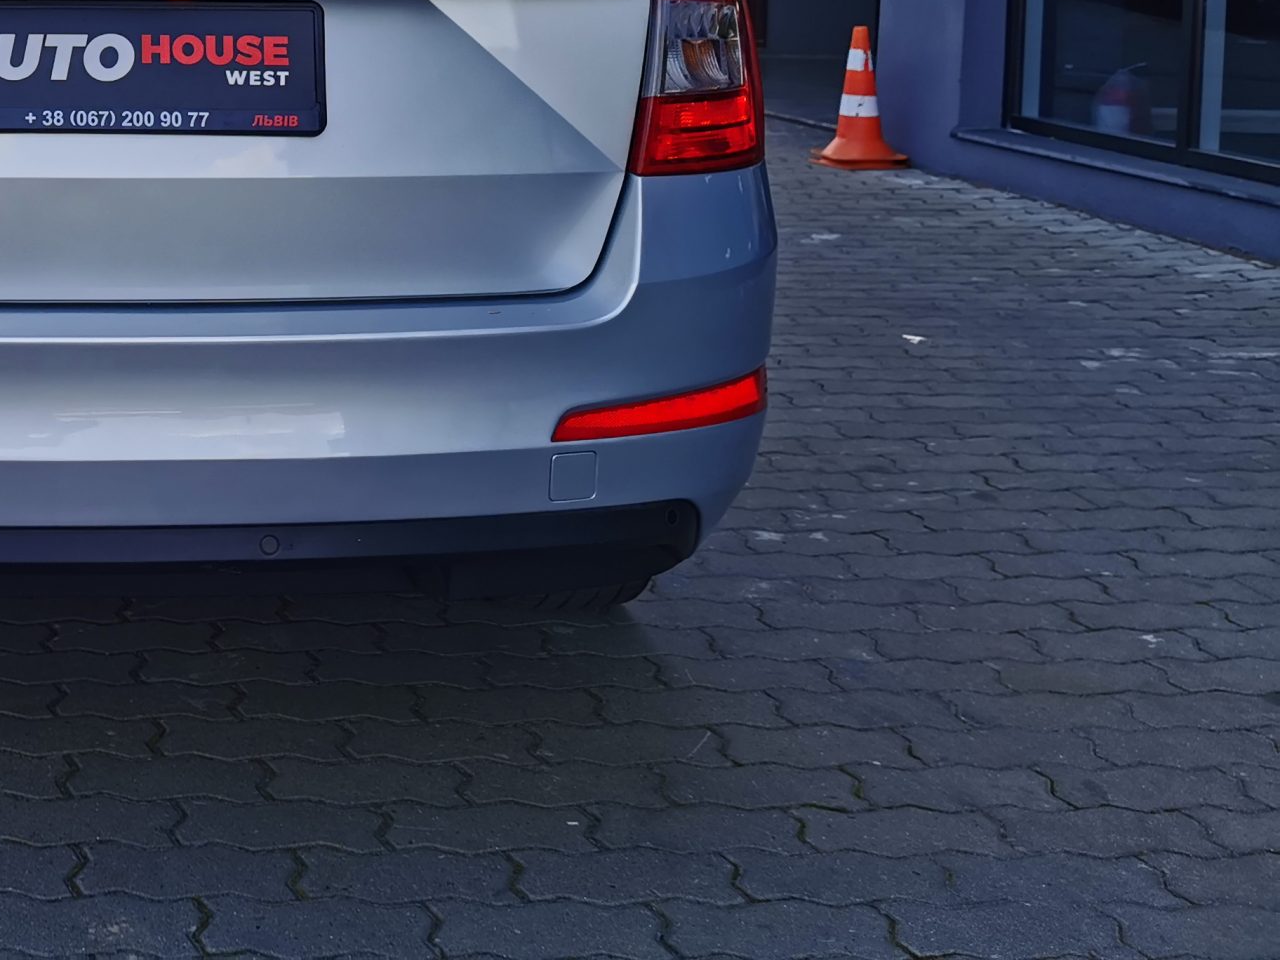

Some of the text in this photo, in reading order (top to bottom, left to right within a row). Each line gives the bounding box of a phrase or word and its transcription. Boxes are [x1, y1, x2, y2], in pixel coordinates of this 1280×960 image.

[141, 34, 289, 66] HOUSE
[225, 70, 289, 86] WEST
[42, 110, 64, 126] 38
[70, 110, 115, 127] (067)
[121, 111, 154, 127] 200
[160, 111, 182, 127] 90
[187, 112, 210, 128] 77
